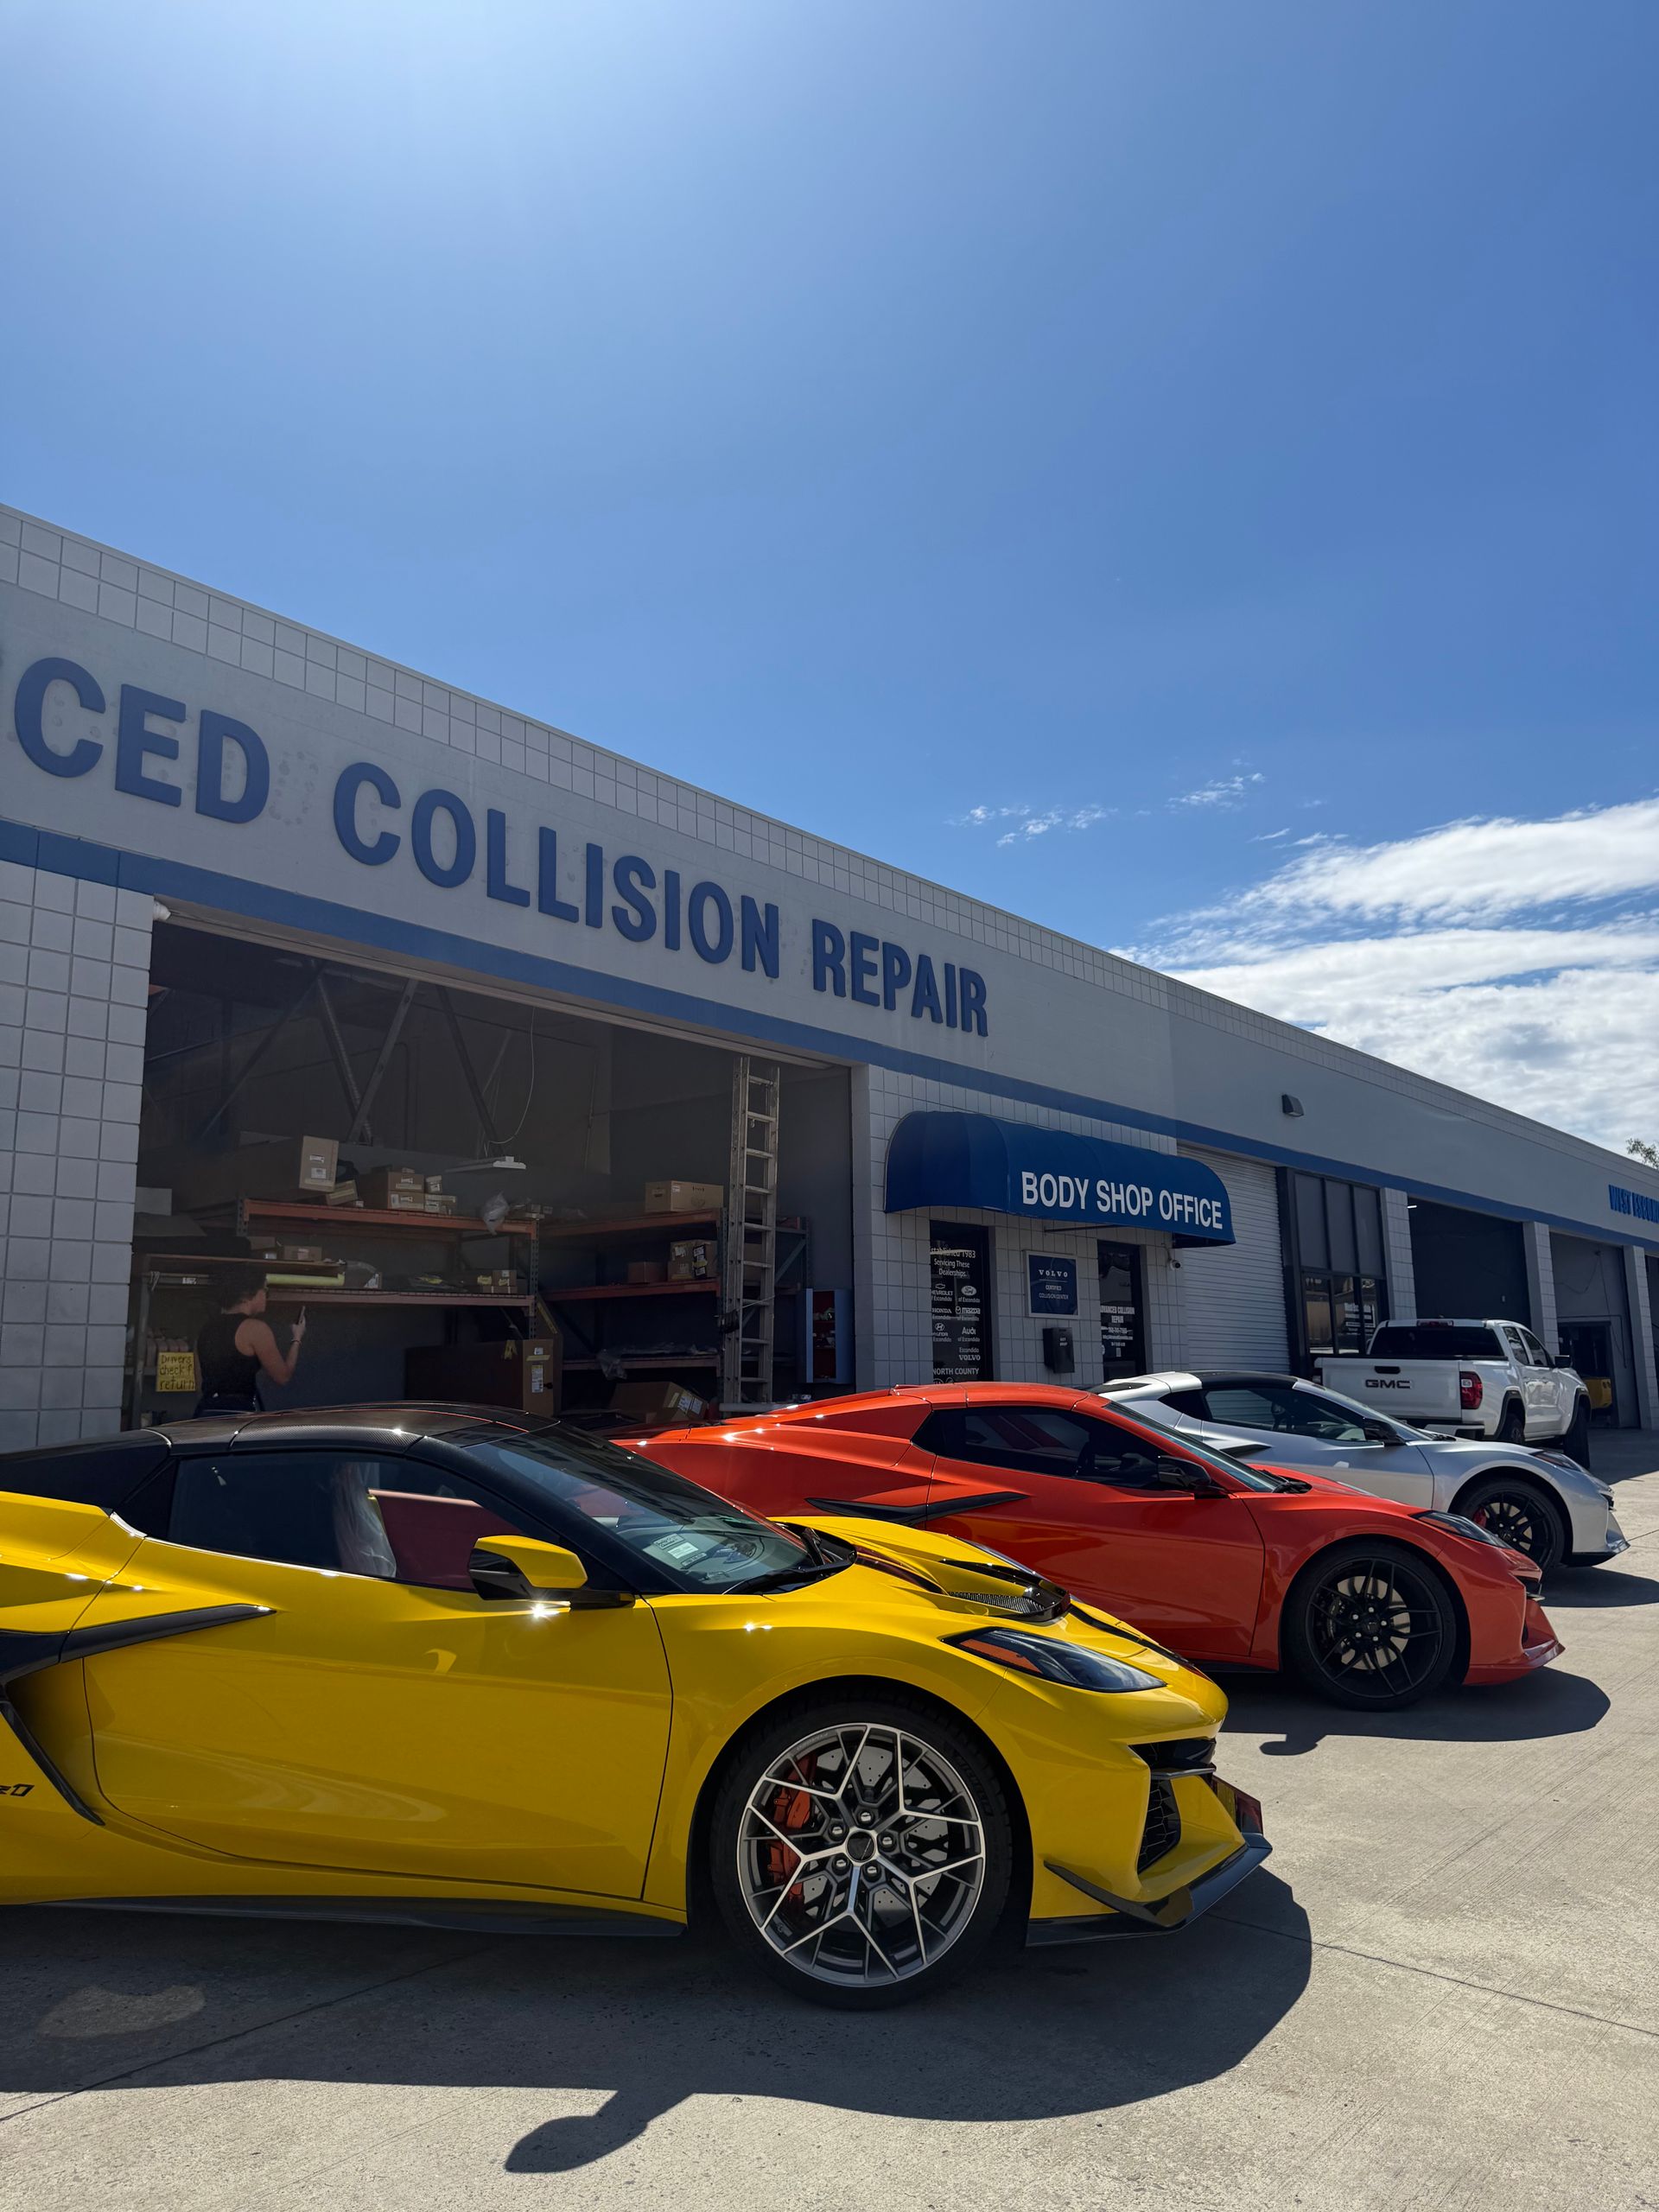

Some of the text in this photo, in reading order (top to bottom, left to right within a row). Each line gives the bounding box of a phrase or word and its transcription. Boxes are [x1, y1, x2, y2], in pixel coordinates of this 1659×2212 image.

[0, 646, 988, 1037] CED COLLISION REPAIR
[1021, 1171, 1223, 1230] BODY SHOP OFFICE
[961, 1249, 976, 1258] 1983
[934, 1258, 970, 1268] Servicing These
[1039, 1269, 1068, 1278] VOLVO
[933, 1367, 954, 1376] NORTH
[1365, 1379, 1411, 1389] GMC
